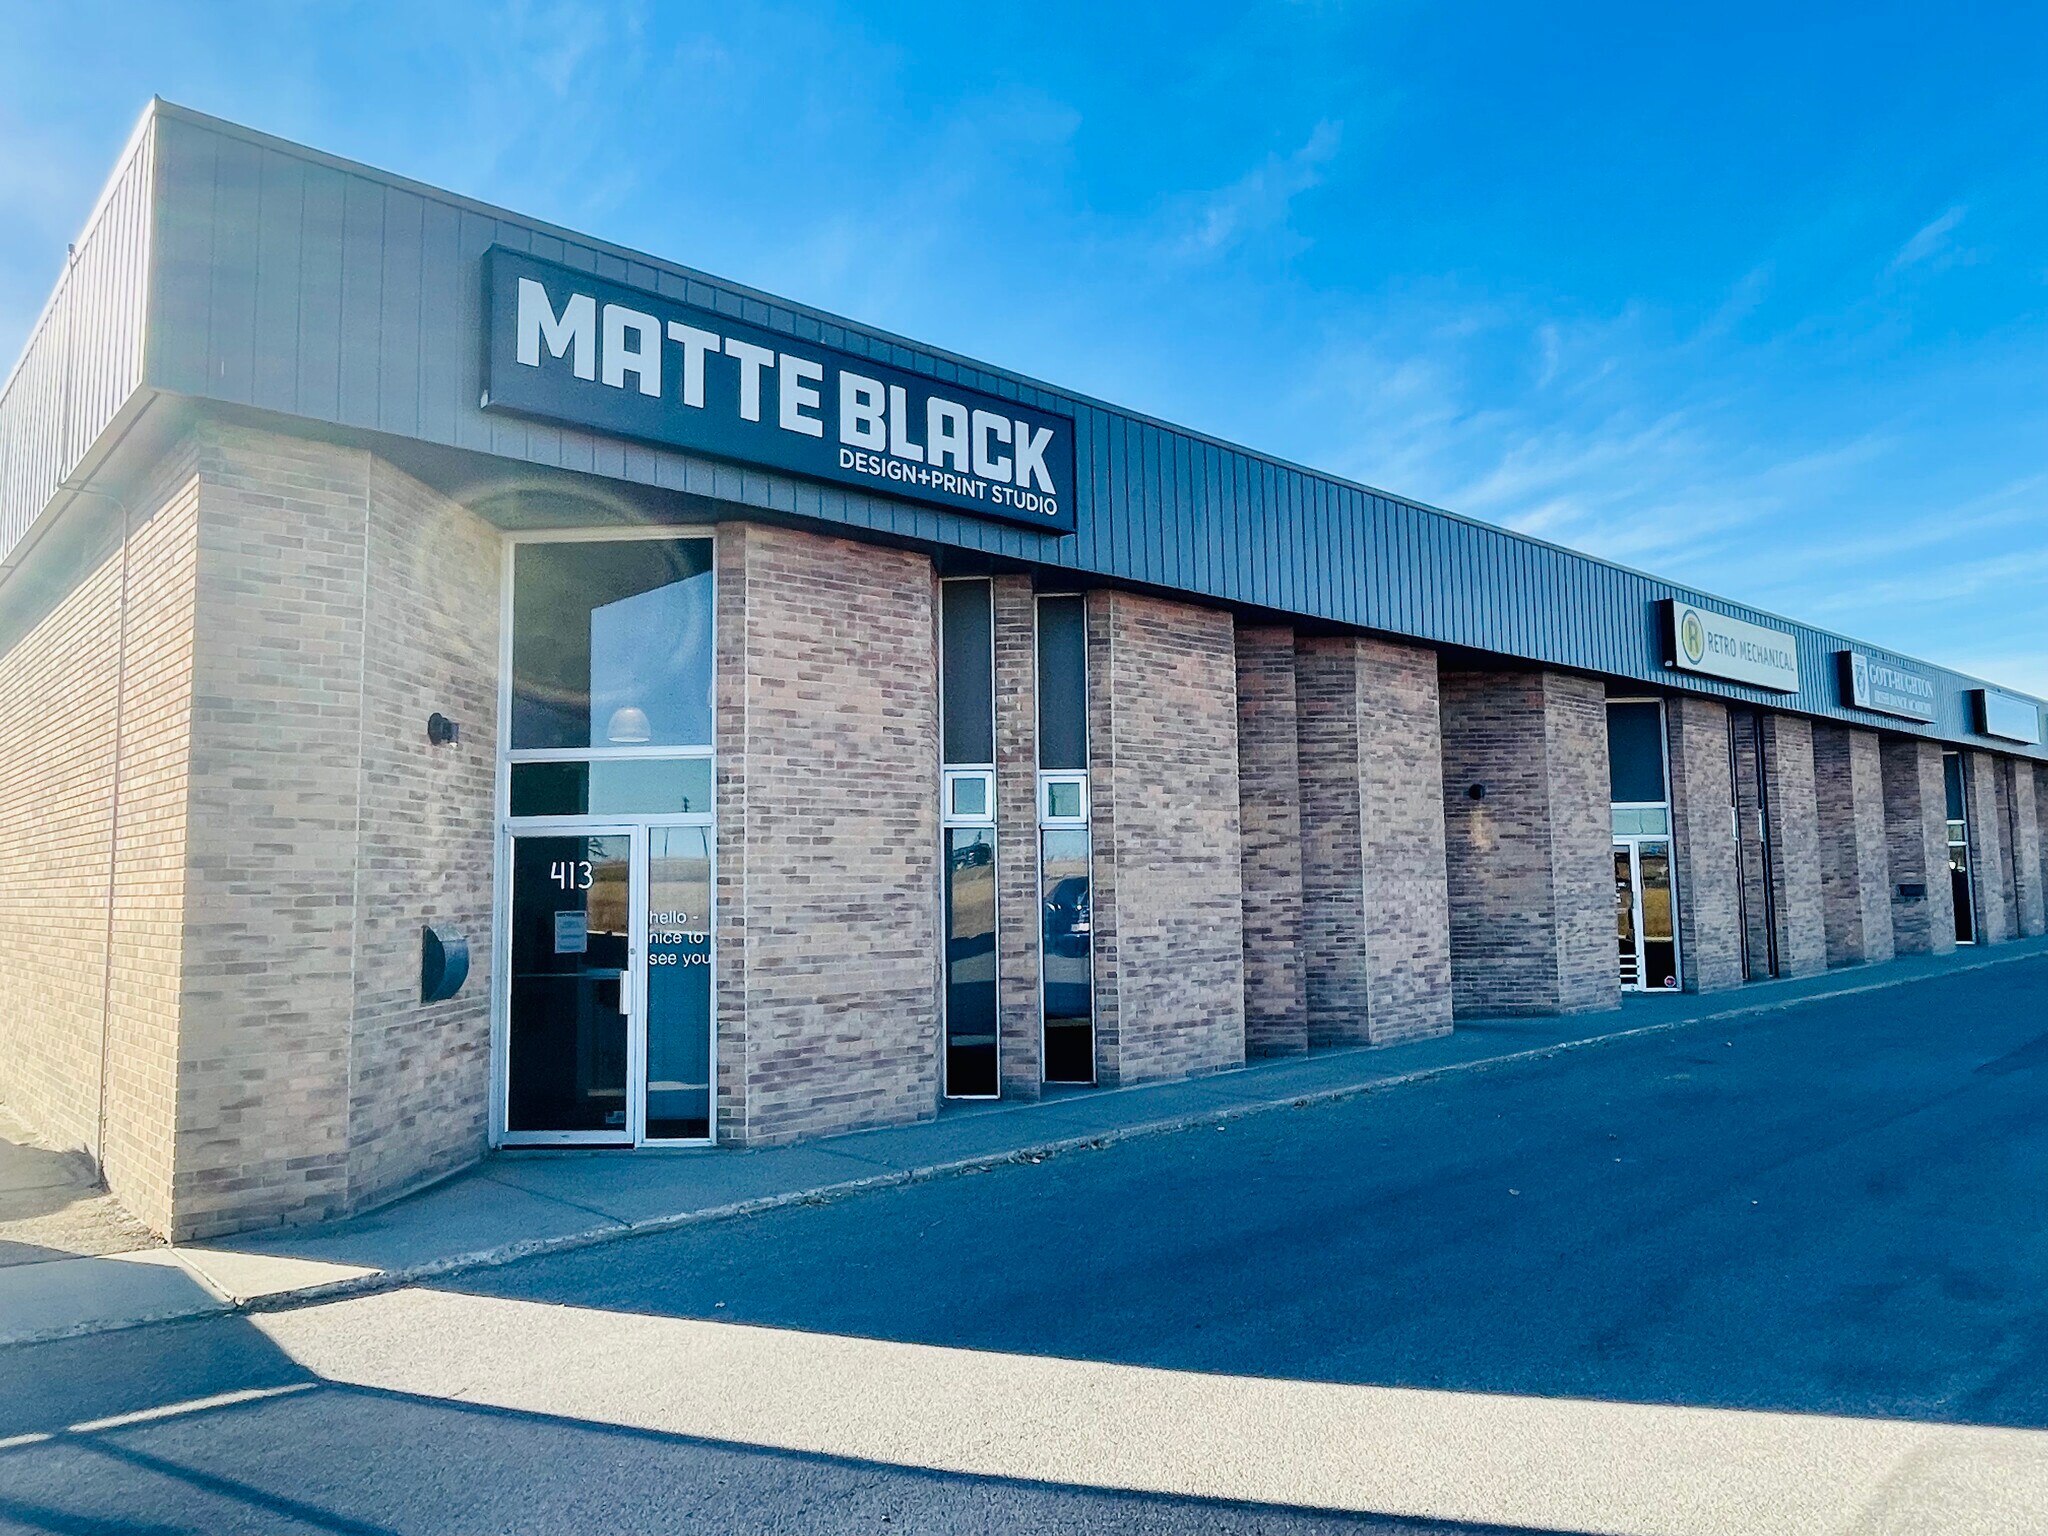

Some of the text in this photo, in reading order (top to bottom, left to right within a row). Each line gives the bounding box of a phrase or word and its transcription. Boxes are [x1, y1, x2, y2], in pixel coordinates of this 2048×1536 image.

[515, 276, 1057, 495] MATTE BLACK
[839, 448, 1058, 516] DESIGN+PRINT STUDIO
[1707, 631, 1795, 672] RETRO MECHANICAL
[550, 860, 594, 890] 413
[649, 910, 687, 924] hello
[649, 931, 704, 944] nice to
[649, 953, 711, 967] see you
